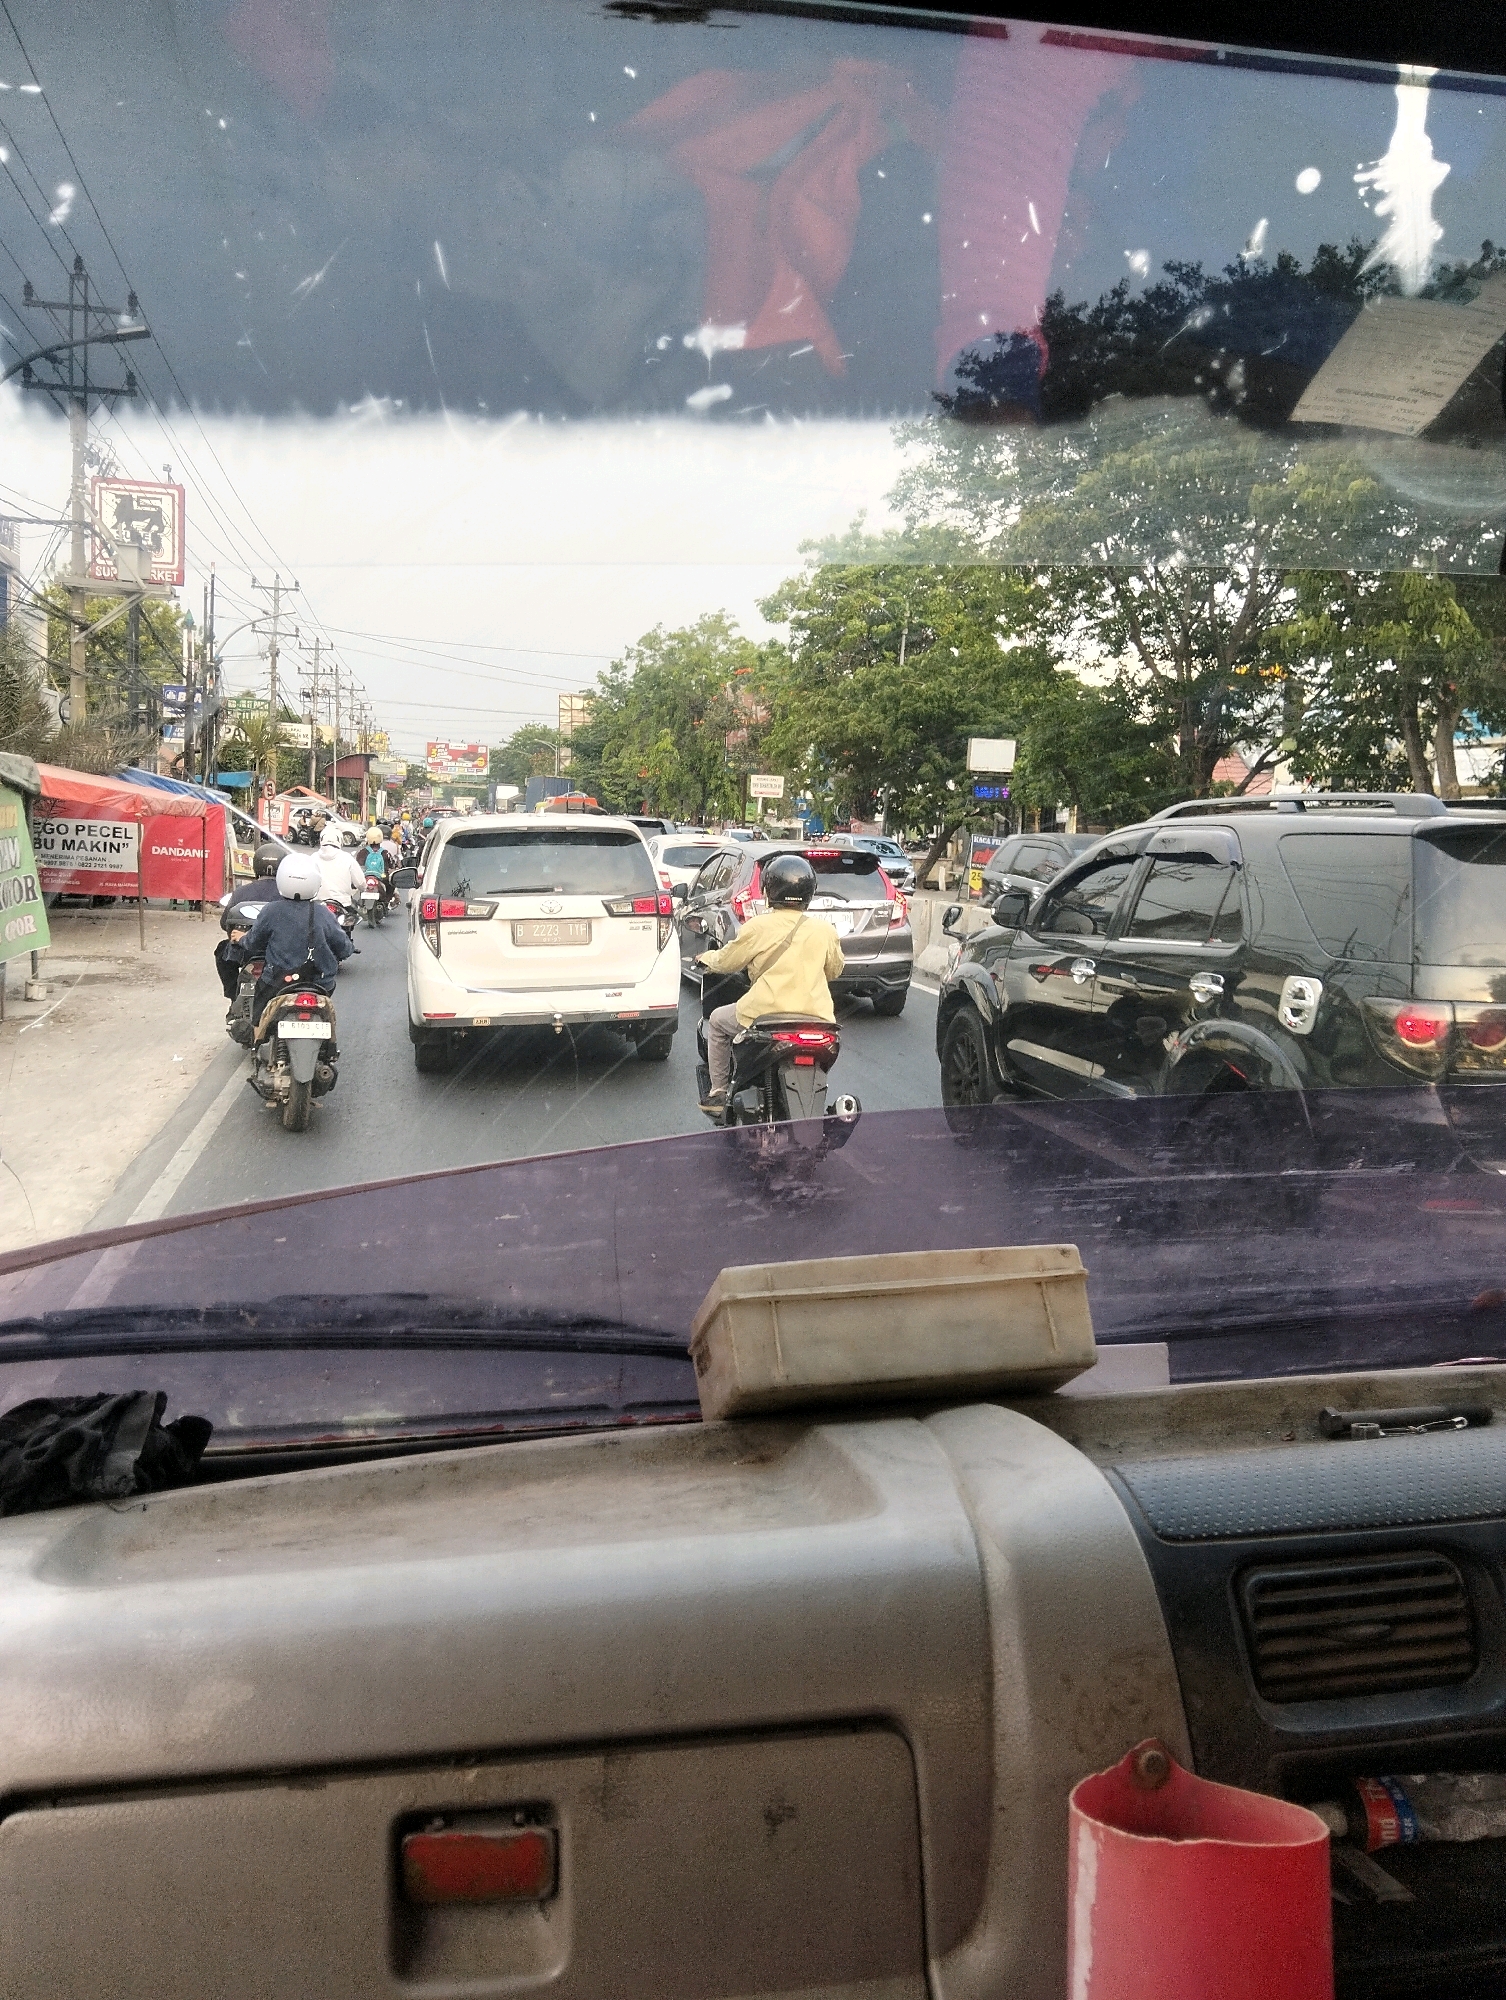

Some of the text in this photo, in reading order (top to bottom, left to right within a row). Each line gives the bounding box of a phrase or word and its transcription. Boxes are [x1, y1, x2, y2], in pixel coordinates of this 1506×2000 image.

[95, 565, 179, 582] SUPRKET
[178, 691, 202, 704] BA
[75, 824, 133, 839] PECEL
[974, 836, 990, 845] KACA
[151, 846, 210, 858] DANDANG
[517, 923, 587, 937] B 2223 TYF
